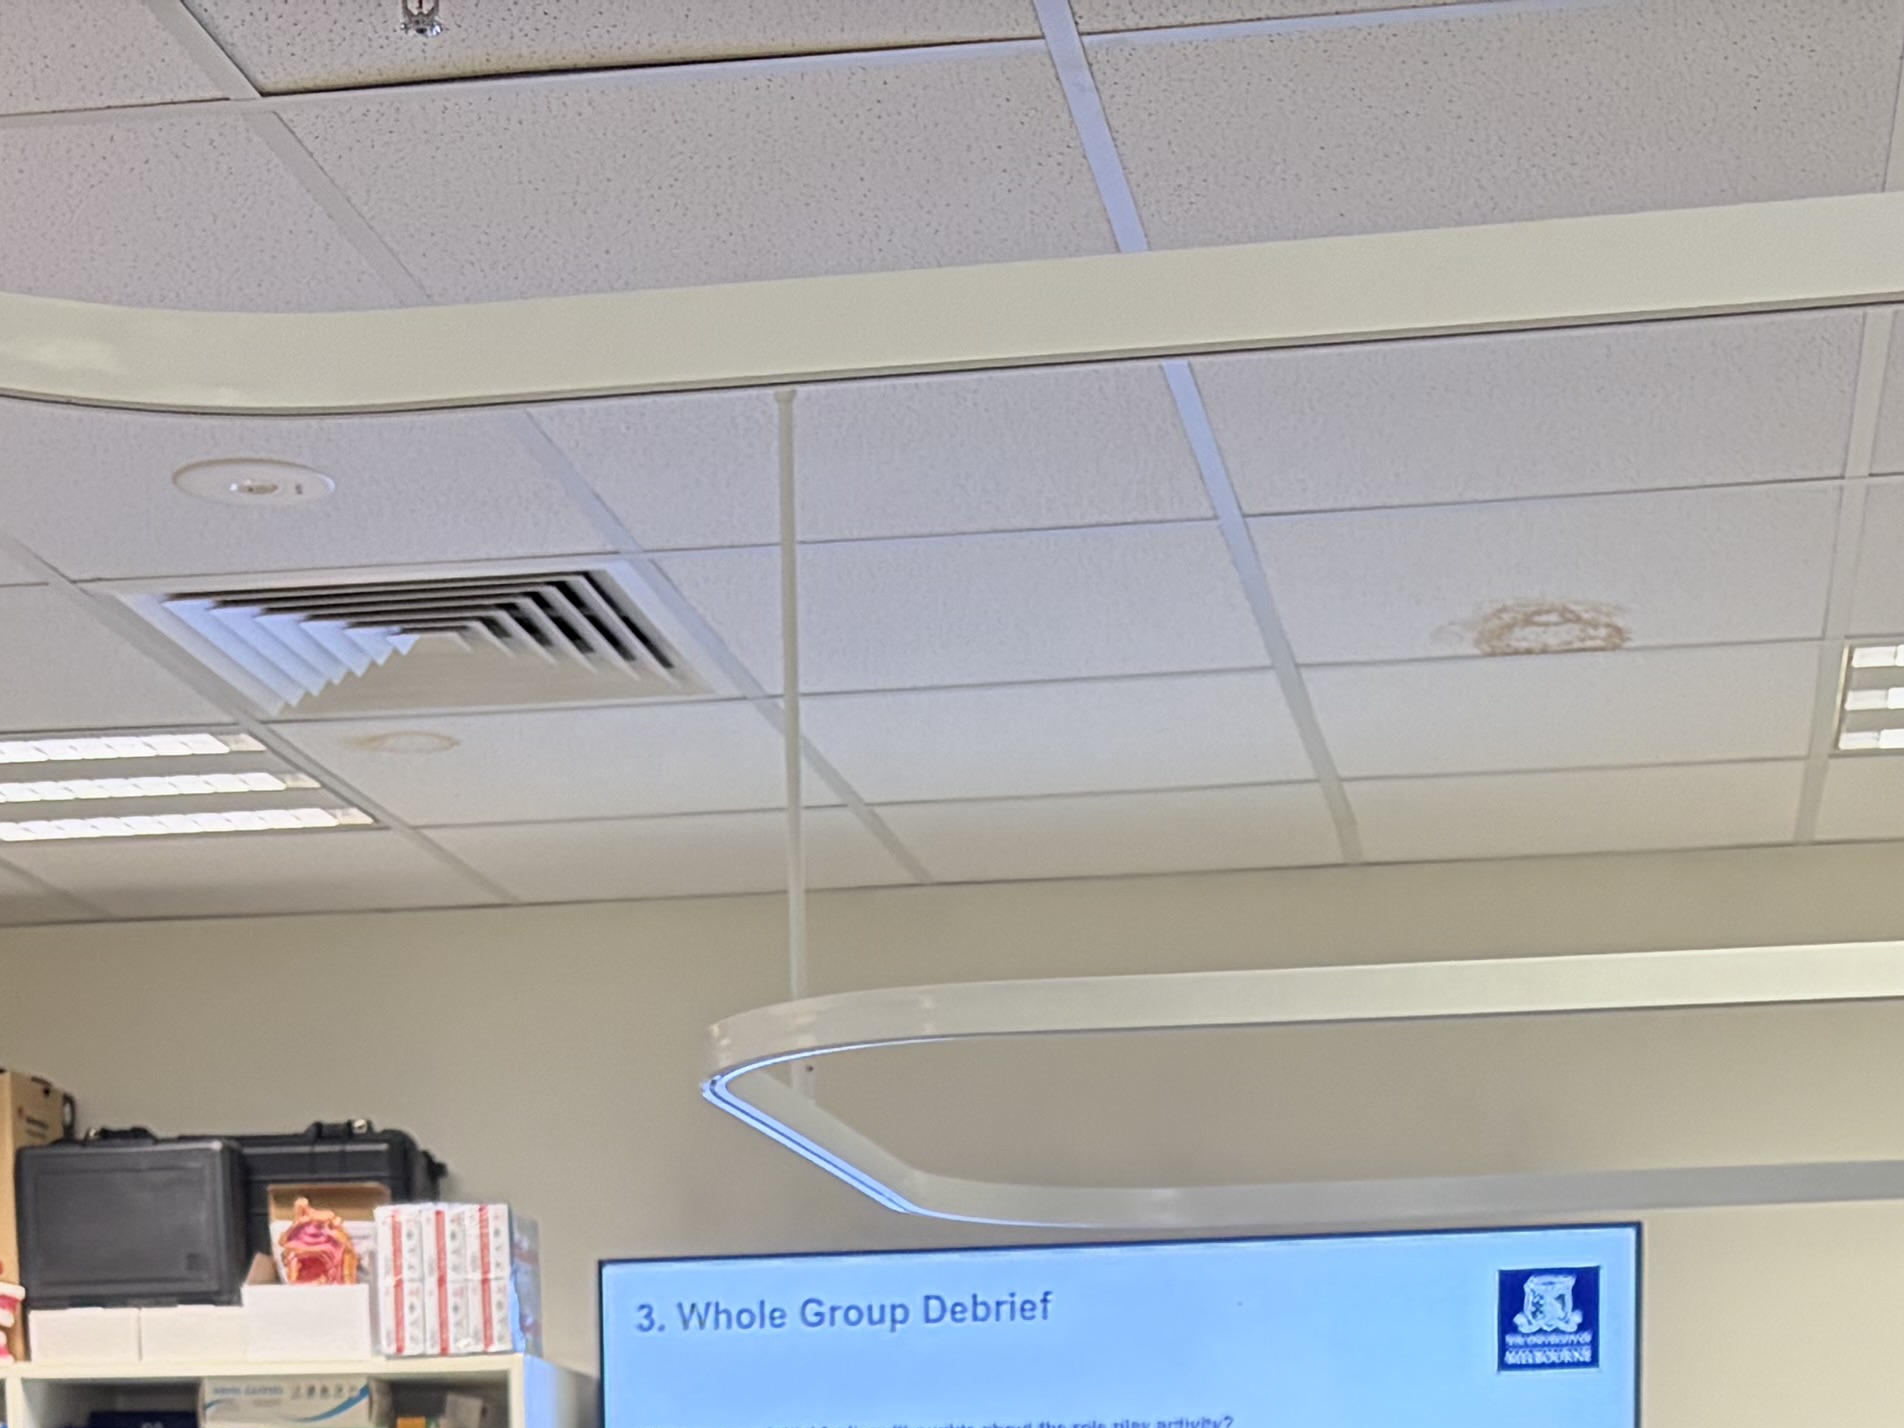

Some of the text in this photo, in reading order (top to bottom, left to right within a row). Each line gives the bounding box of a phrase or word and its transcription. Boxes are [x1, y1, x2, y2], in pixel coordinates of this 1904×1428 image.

[635, 1291, 1053, 1332] 3. Whole Group Debrief
